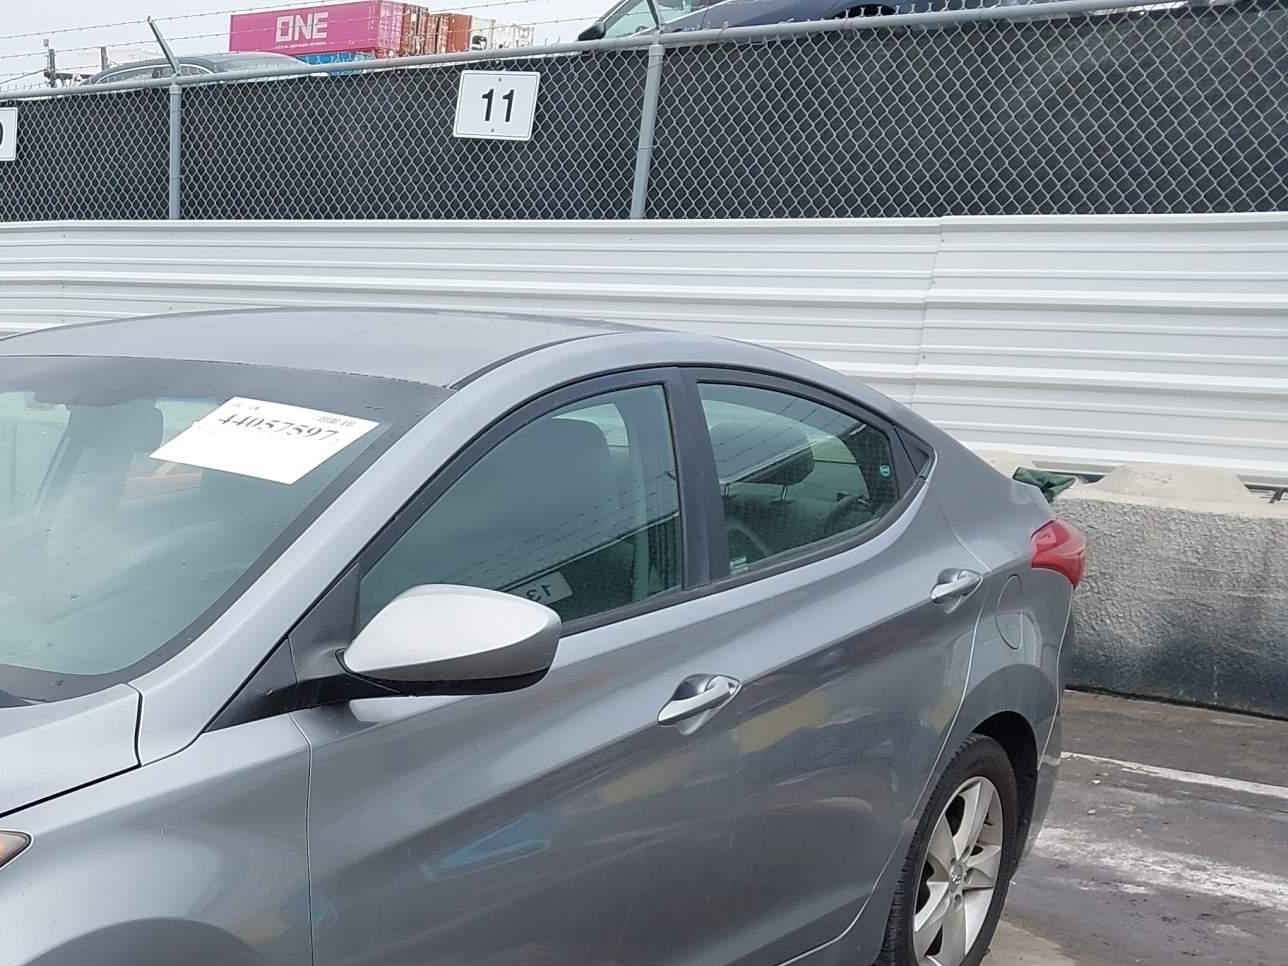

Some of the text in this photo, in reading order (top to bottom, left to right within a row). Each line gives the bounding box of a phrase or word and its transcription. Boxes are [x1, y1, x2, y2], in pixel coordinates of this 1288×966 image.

[275, 12, 329, 43] ONE
[481, 88, 515, 123] 11
[218, 414, 339, 441] 44057597
